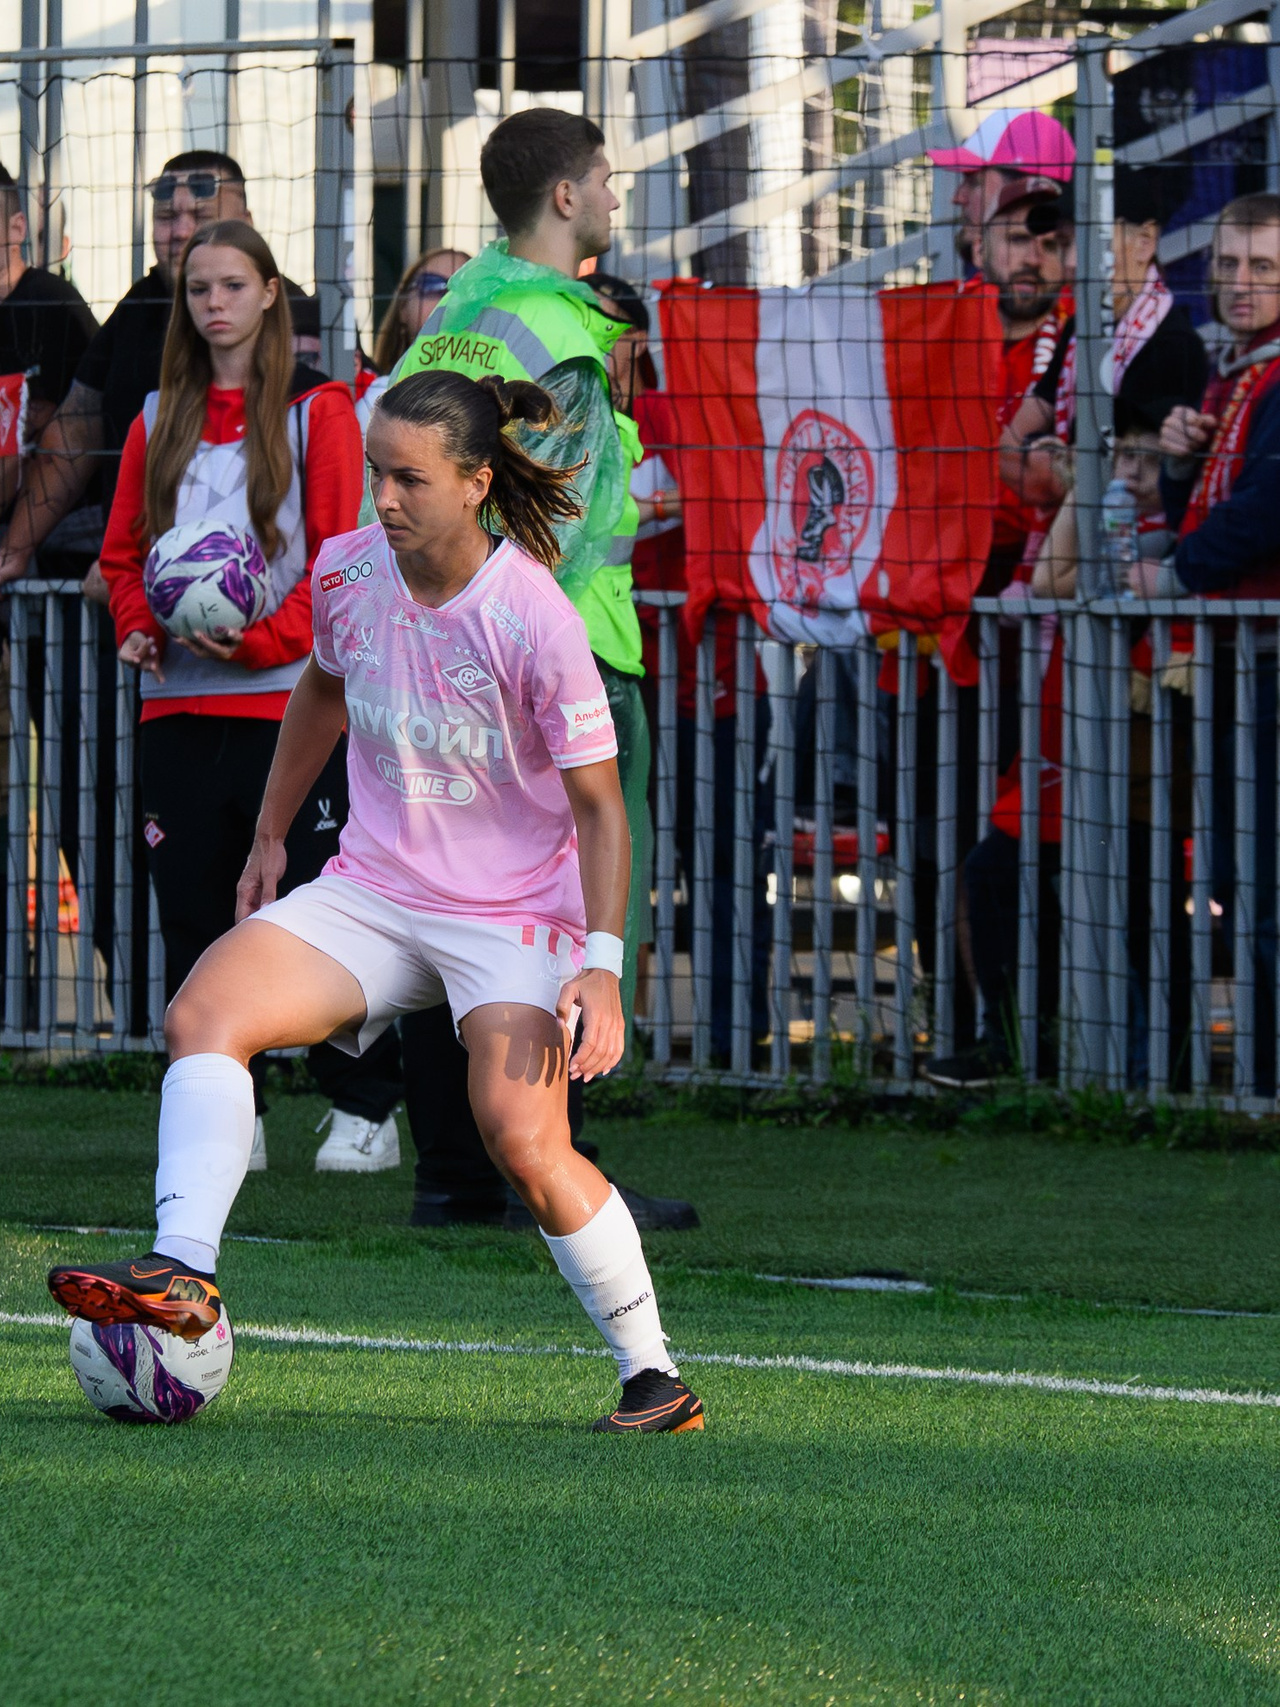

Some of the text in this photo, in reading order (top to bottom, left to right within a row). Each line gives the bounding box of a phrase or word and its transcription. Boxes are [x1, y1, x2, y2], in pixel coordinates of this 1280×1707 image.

[480, 602, 535, 655] ПРОТЕКТ
[487, 594, 526, 632] КИБЕР
[346, 697, 503, 759] ЛУКОЙЛ
